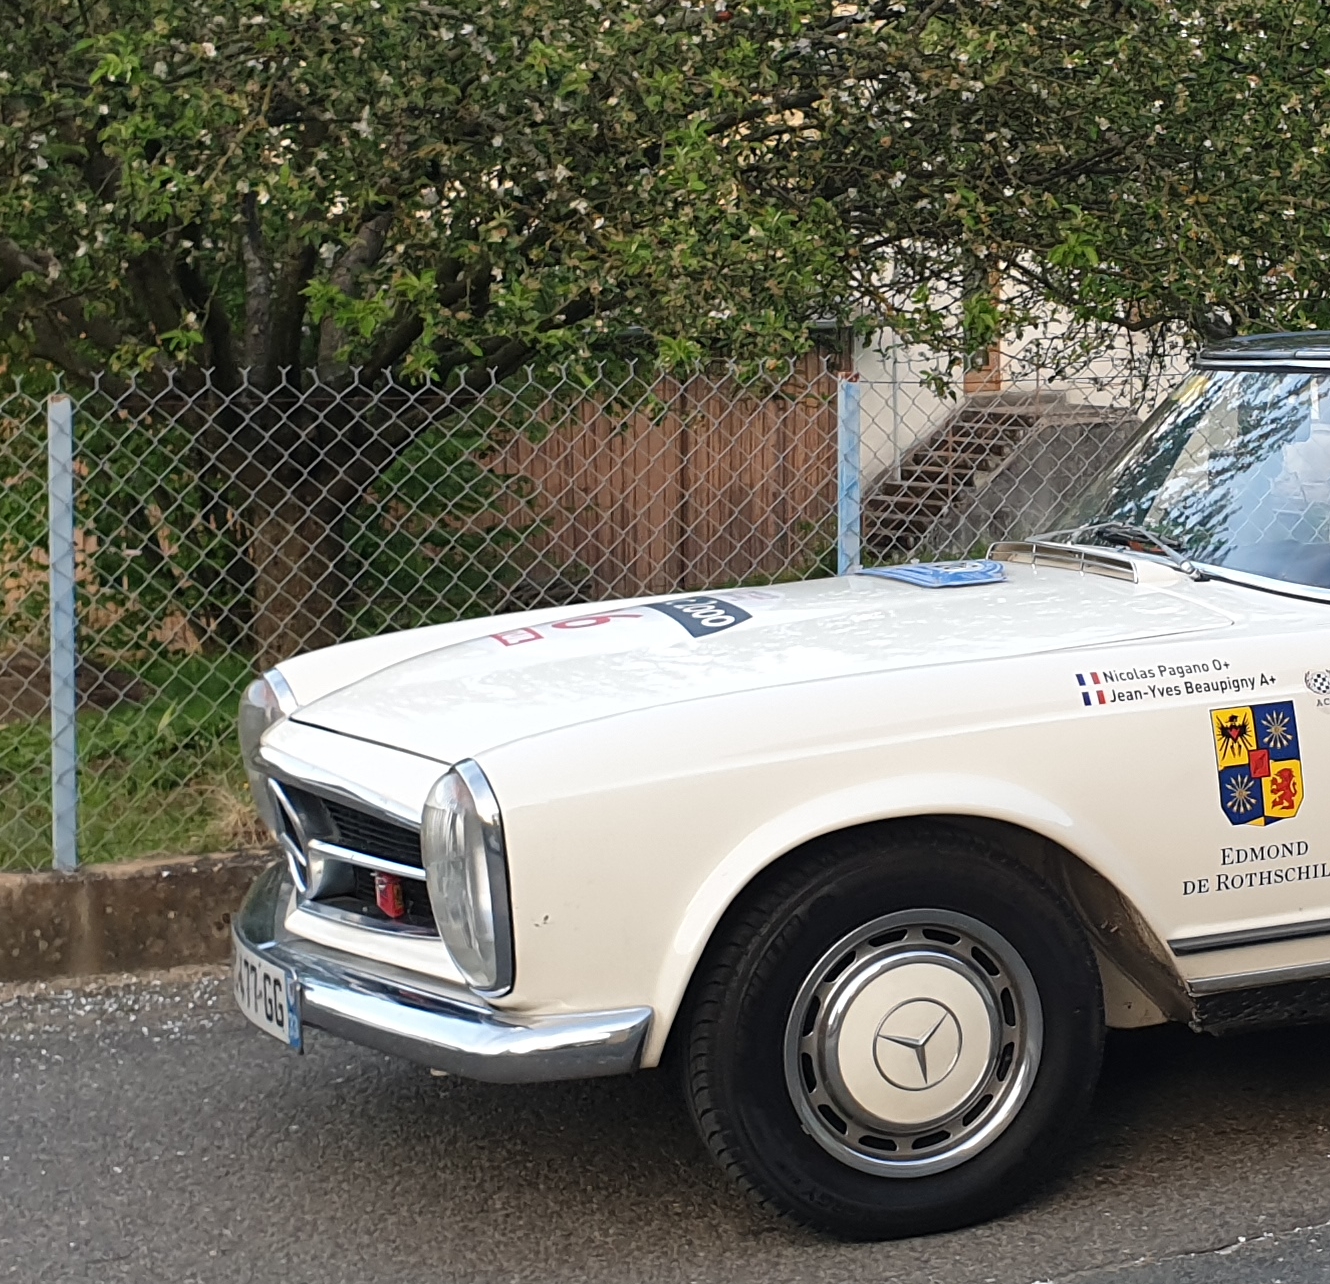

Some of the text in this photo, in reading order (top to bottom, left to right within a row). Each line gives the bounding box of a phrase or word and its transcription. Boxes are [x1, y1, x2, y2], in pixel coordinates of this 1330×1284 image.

[1102, 667, 1156, 685] Nicolas
[1158, 662, 1210, 681] Pagano
[1109, 672, 1277, 704] Jean-Yves Beaupigny A+
[1220, 840, 1310, 866] EDMOND
